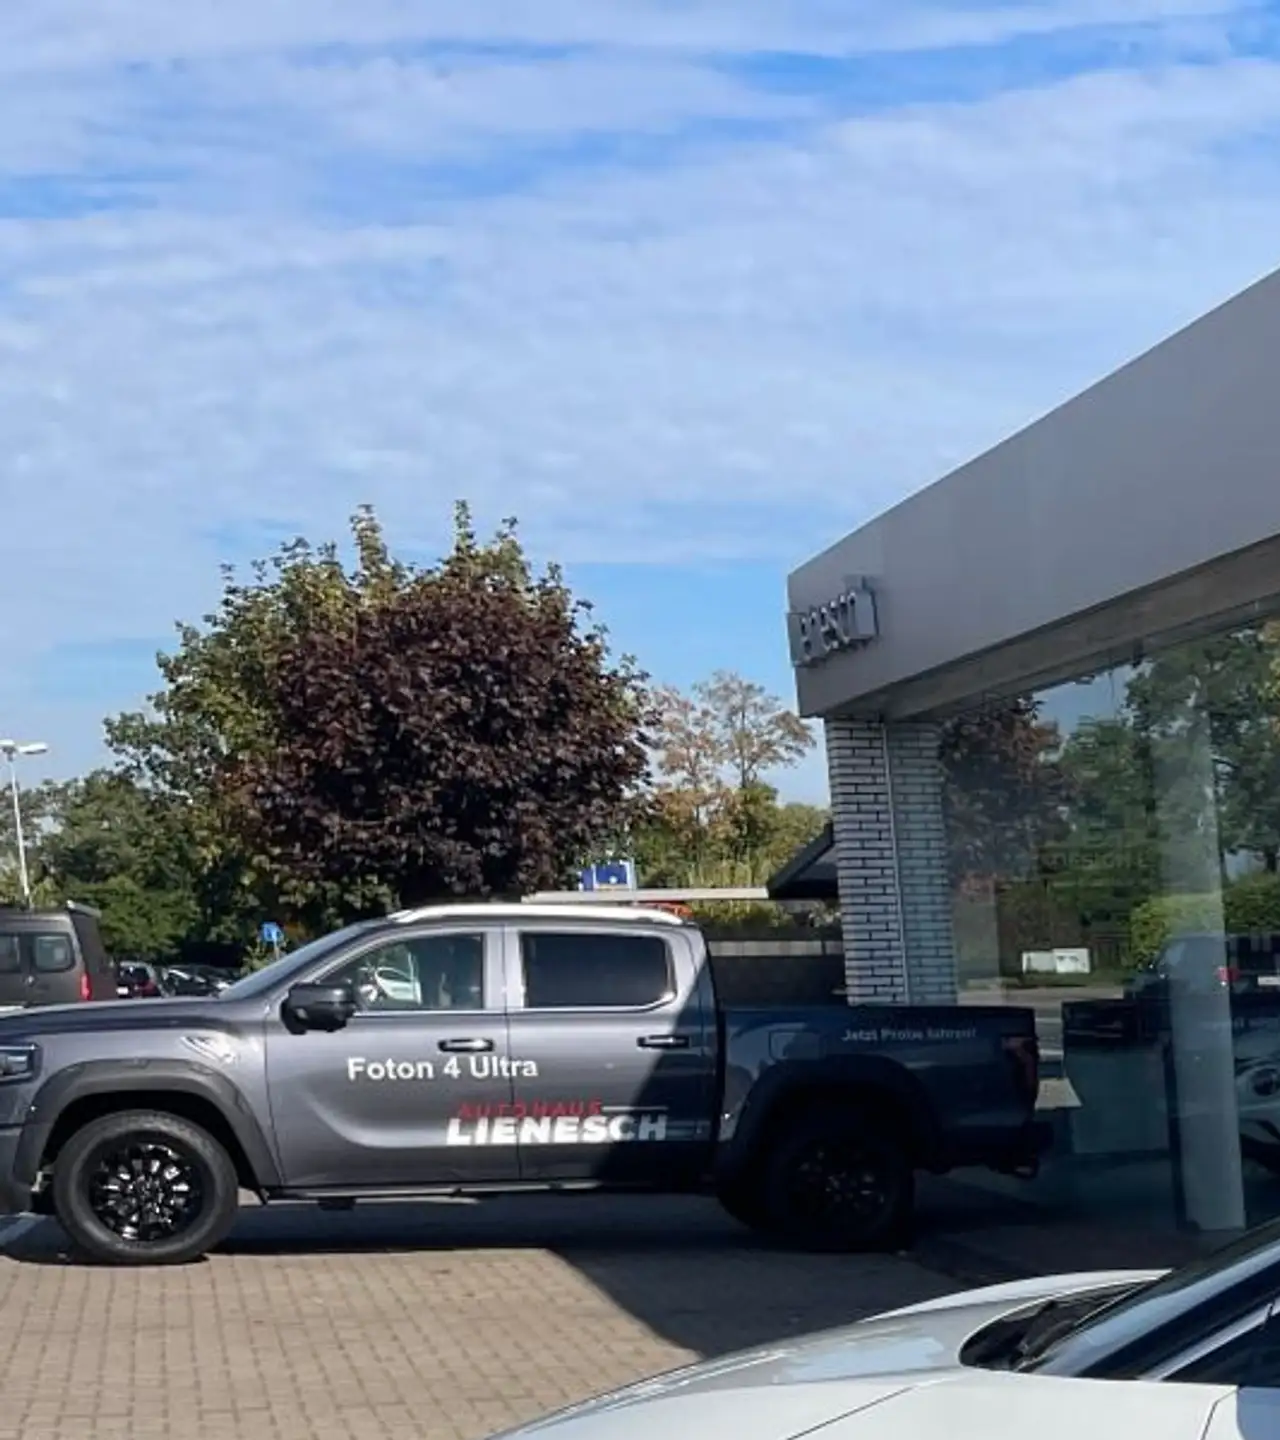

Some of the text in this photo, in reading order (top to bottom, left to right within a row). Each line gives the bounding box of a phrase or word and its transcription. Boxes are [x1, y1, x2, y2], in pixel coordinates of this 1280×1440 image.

[347, 1055, 539, 1081] Foton 4 Ultra
[459, 1097, 603, 1118] AUTOHAUS
[446, 1114, 668, 1145] LIENESCH
